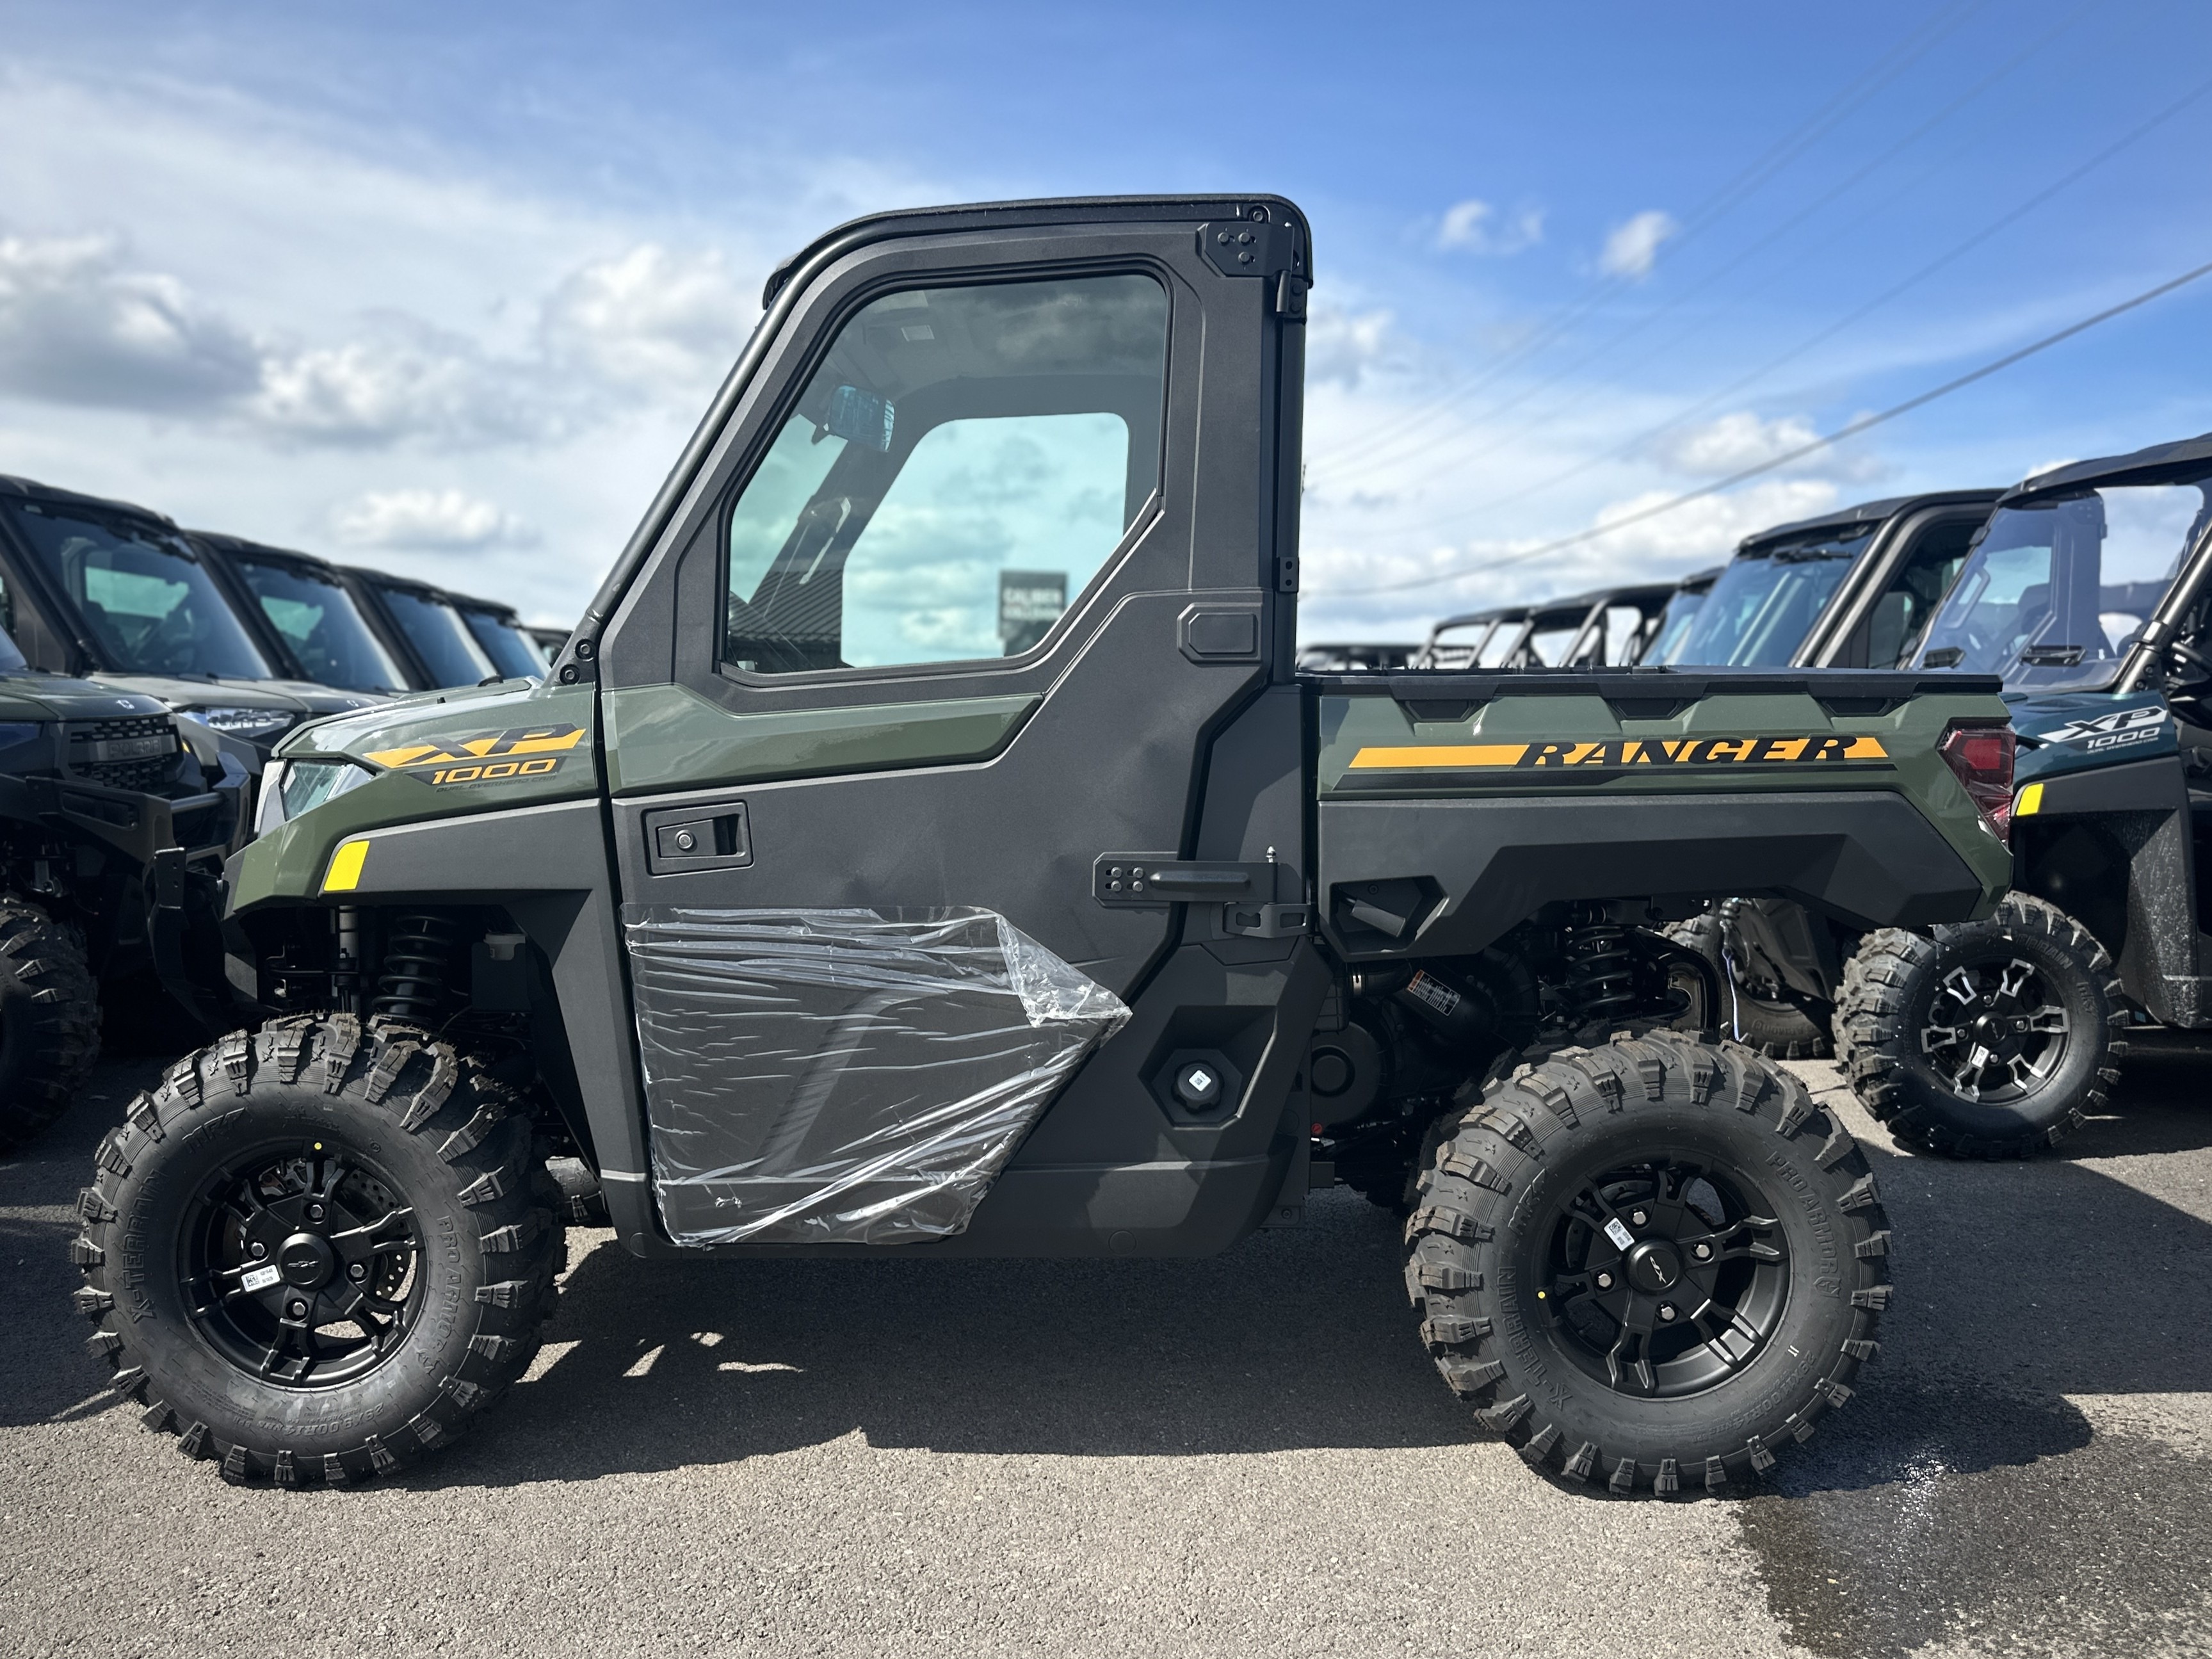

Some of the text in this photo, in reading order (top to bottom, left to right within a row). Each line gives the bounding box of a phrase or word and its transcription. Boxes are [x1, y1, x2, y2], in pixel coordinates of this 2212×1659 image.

[2056, 706, 2166, 741] XP
[2087, 727, 2161, 749] 1000
[391, 723, 581, 766] XP
[1514, 736, 1858, 768] RANGER
[432, 758, 557, 785] 1000
[1765, 1151, 1839, 1275] PRO ARMOR
[437, 1215, 460, 1264] PRO
[1496, 1265, 1573, 1412] X-TERRAIN
